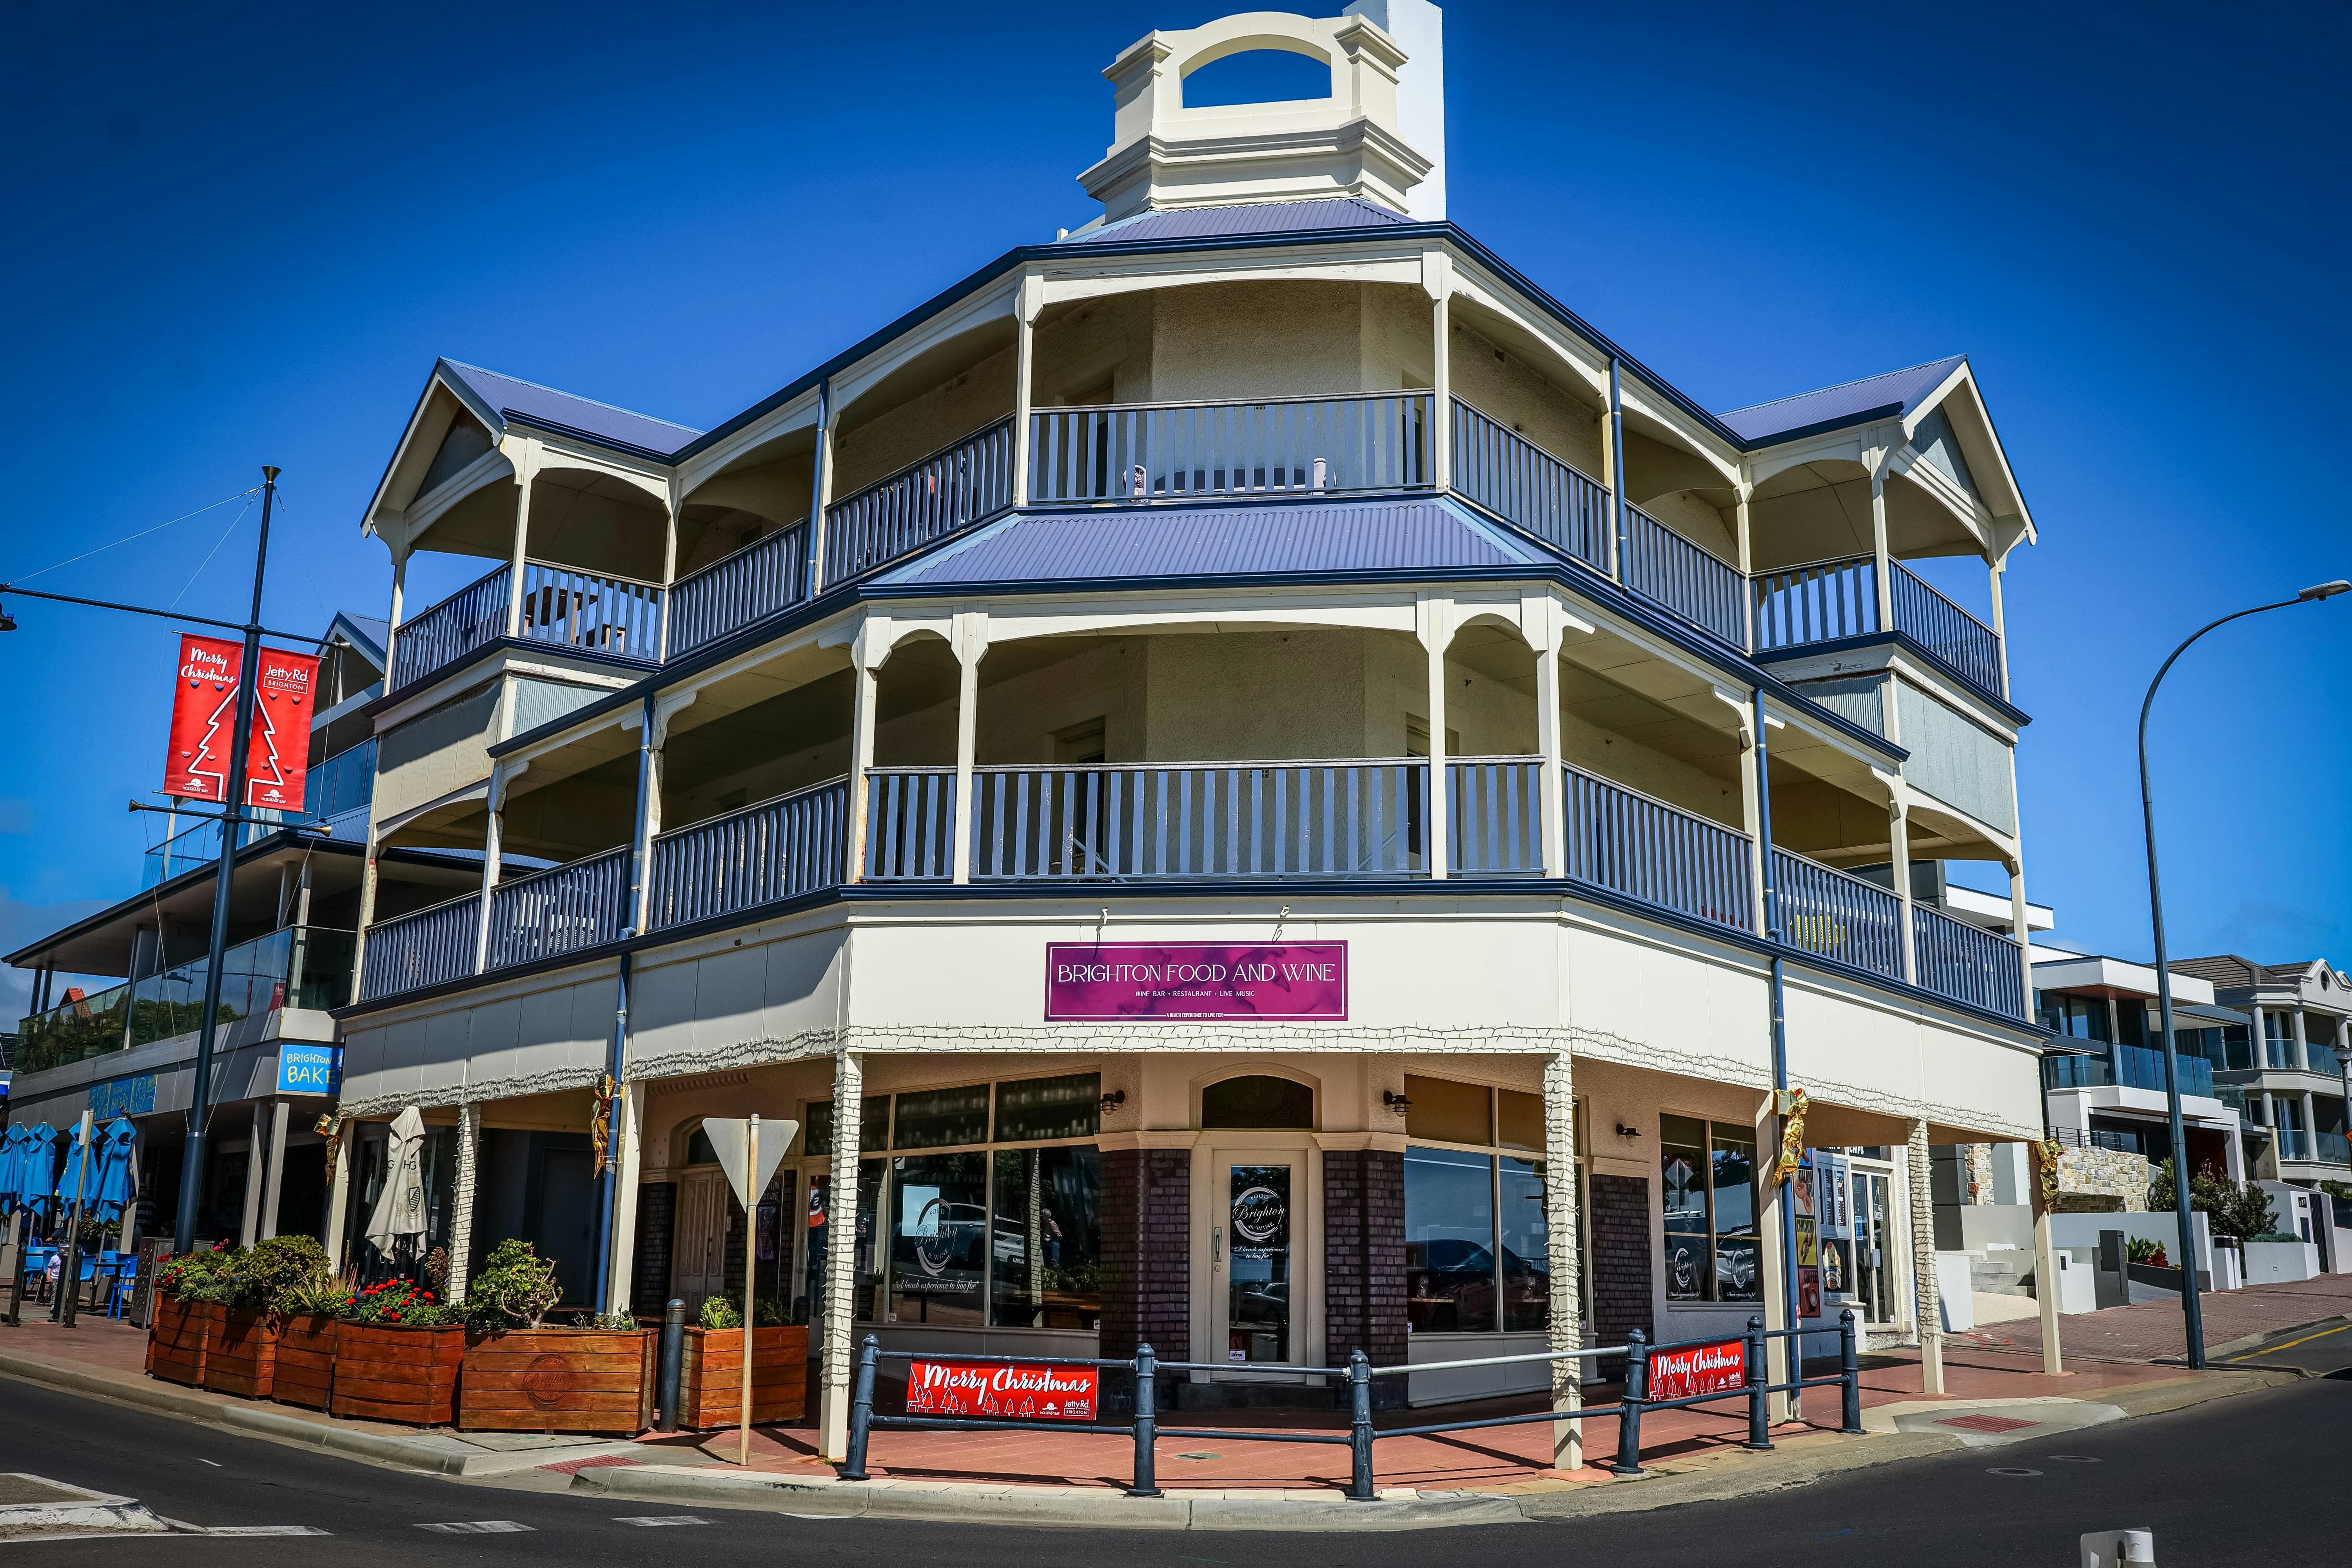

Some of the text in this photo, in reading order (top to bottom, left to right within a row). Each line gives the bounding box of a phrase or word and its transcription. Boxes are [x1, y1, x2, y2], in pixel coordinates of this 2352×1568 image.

[191, 647, 227, 674] Merry
[181, 664, 236, 683] Christmas
[265, 664, 309, 682] Jetty Rd.
[268, 680, 303, 690] BRIGHTON
[1058, 964, 1335, 982] BRIGHTON FOOD AND WINE
[287, 1053, 332, 1064] BRIGHTON
[287, 1066, 336, 1085] BAKE
[1849, 1146, 1864, 1155] CHIPS
[929, 1208, 945, 1217] FOOD
[1232, 1204, 1286, 1223] Brighton
[1256, 1222, 1274, 1230] WINE
[915, 1223, 958, 1250] Brighton
[934, 1247, 949, 1260] WINE
[905, 1279, 920, 1289] beach
[920, 1281, 949, 1292] experience
[956, 1279, 966, 1289] live
[1658, 1347, 1740, 1388] Merry Christmas
[924, 1363, 1091, 1406] Merry Christmas
[1064, 1399, 1090, 1410] Jetty Rd.
